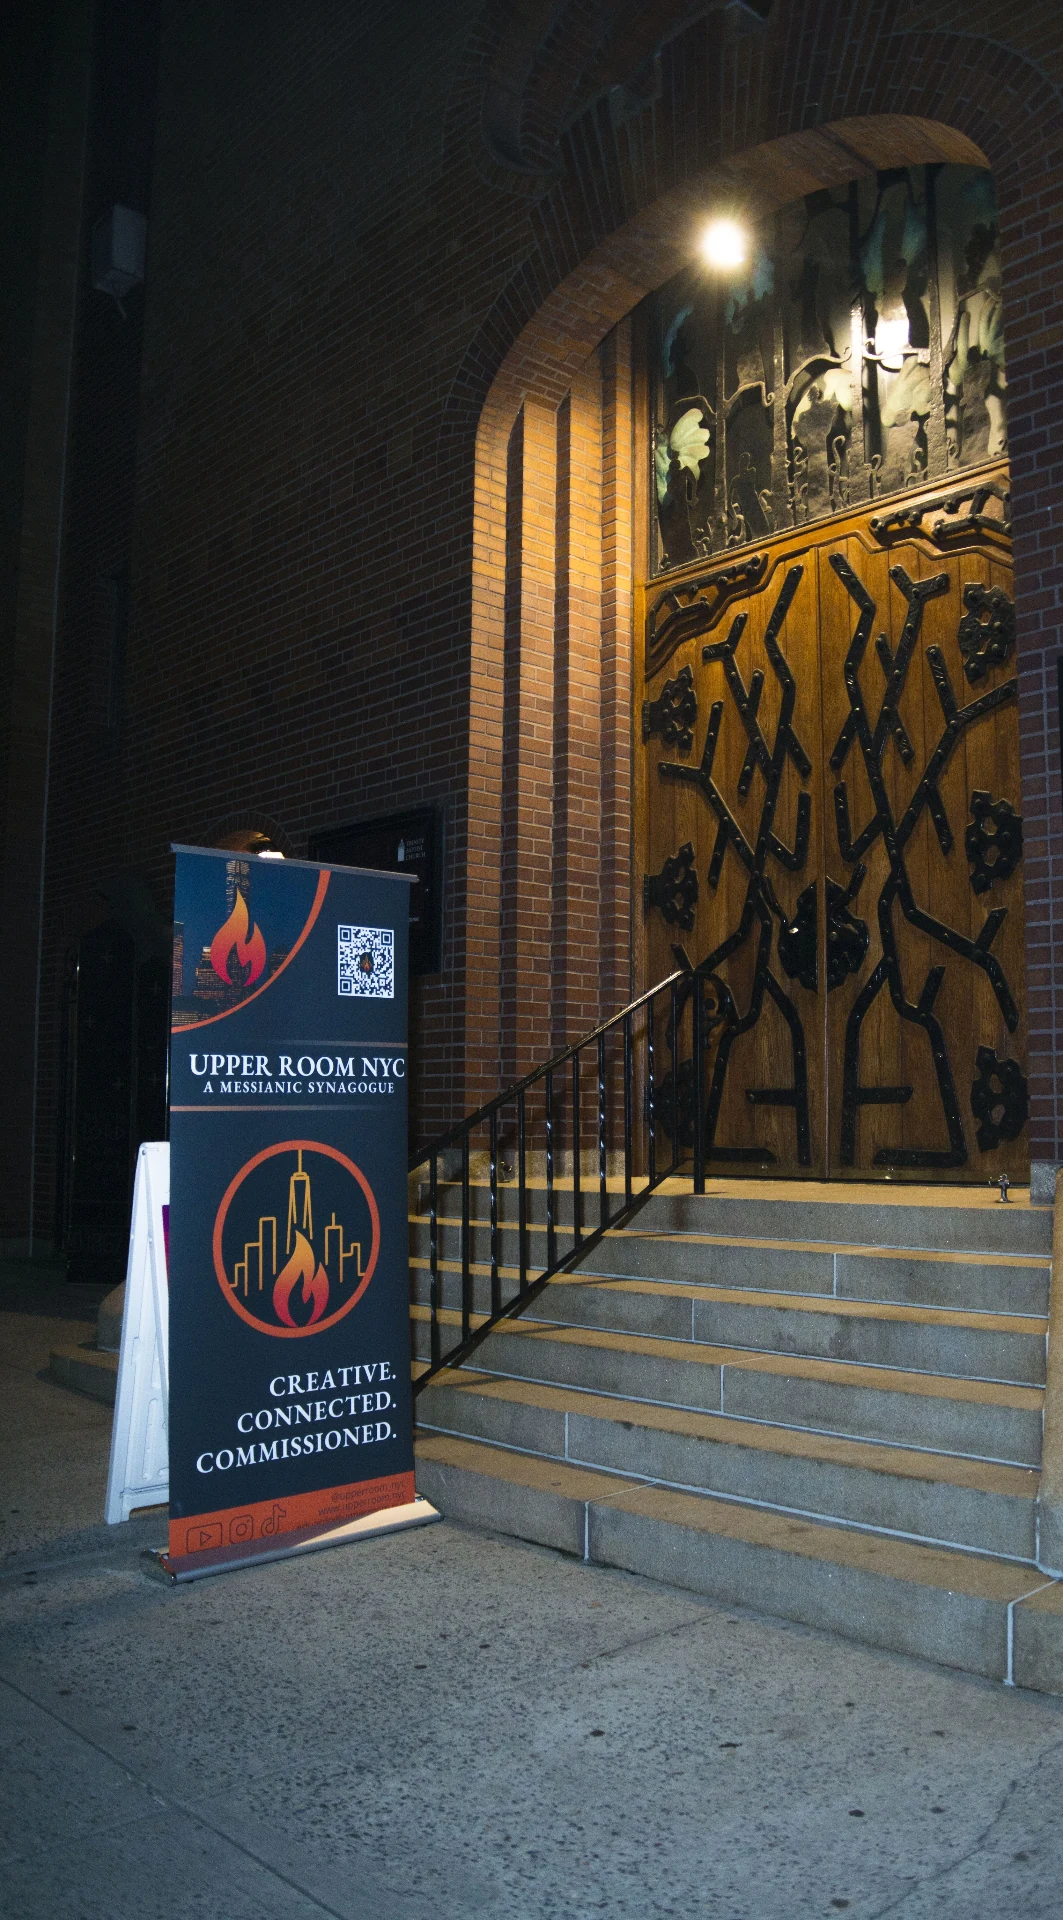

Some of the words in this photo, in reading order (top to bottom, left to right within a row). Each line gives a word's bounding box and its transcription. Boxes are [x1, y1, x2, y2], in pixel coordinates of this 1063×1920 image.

[188, 1053, 273, 1077] UPPER
[278, 1055, 355, 1077] ROOM
[361, 1056, 405, 1078] NYC
[203, 1080, 214, 1093] A
[220, 1080, 303, 1094] MESSIANIC
[307, 1081, 395, 1094] SYNAGOGUE
[269, 1361, 397, 1397] CREATIVE.
[236, 1390, 397, 1433] CONNECTED.
[196, 1421, 397, 1474] COMMISSIONED.
